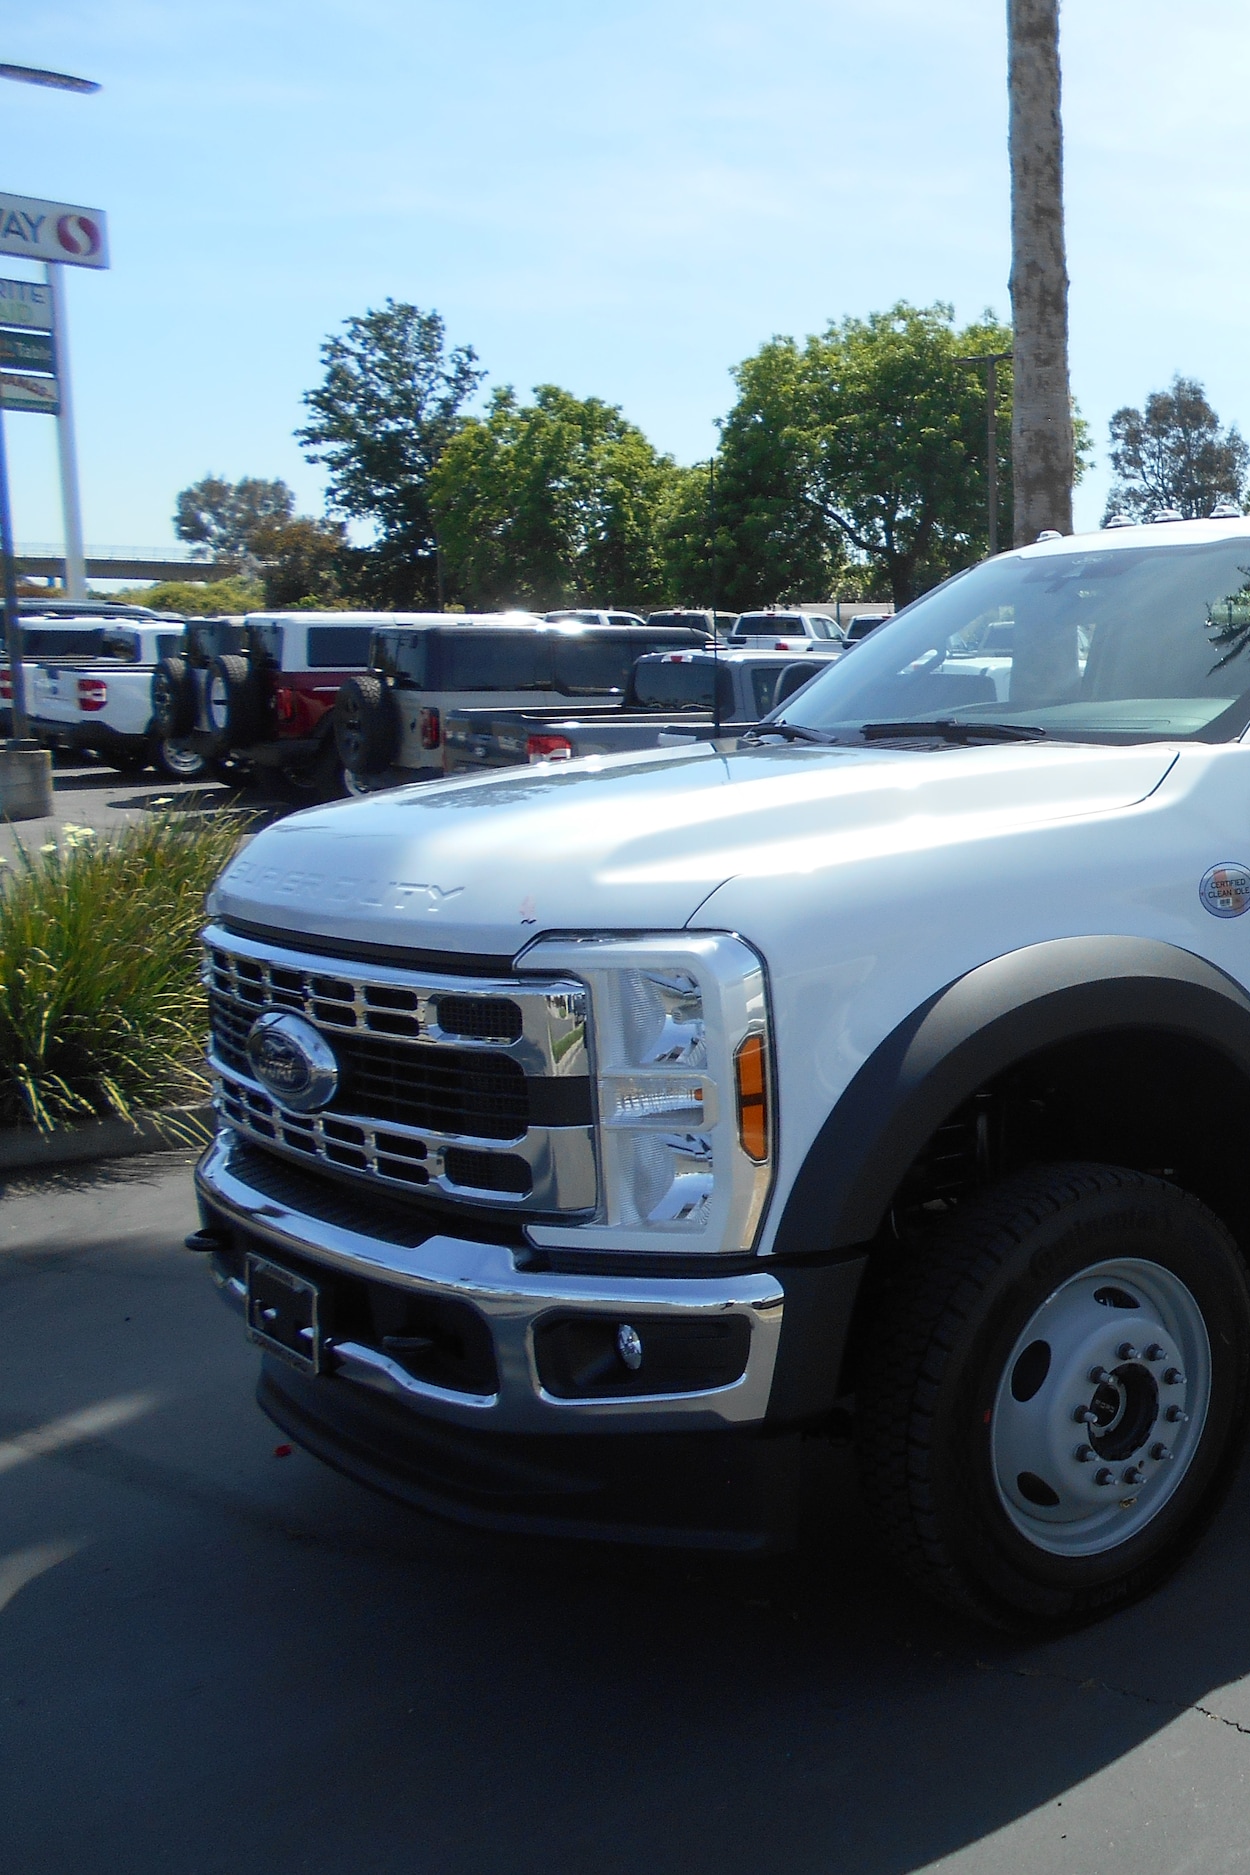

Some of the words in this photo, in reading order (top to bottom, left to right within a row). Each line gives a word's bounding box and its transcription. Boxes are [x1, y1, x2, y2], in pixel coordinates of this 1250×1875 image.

[0, 208, 47, 245] AY
[1210, 878, 1246, 889] CERTIFIED
[1208, 889, 1232, 899] CLEAN
[1234, 886, 1250, 896] IDLE
